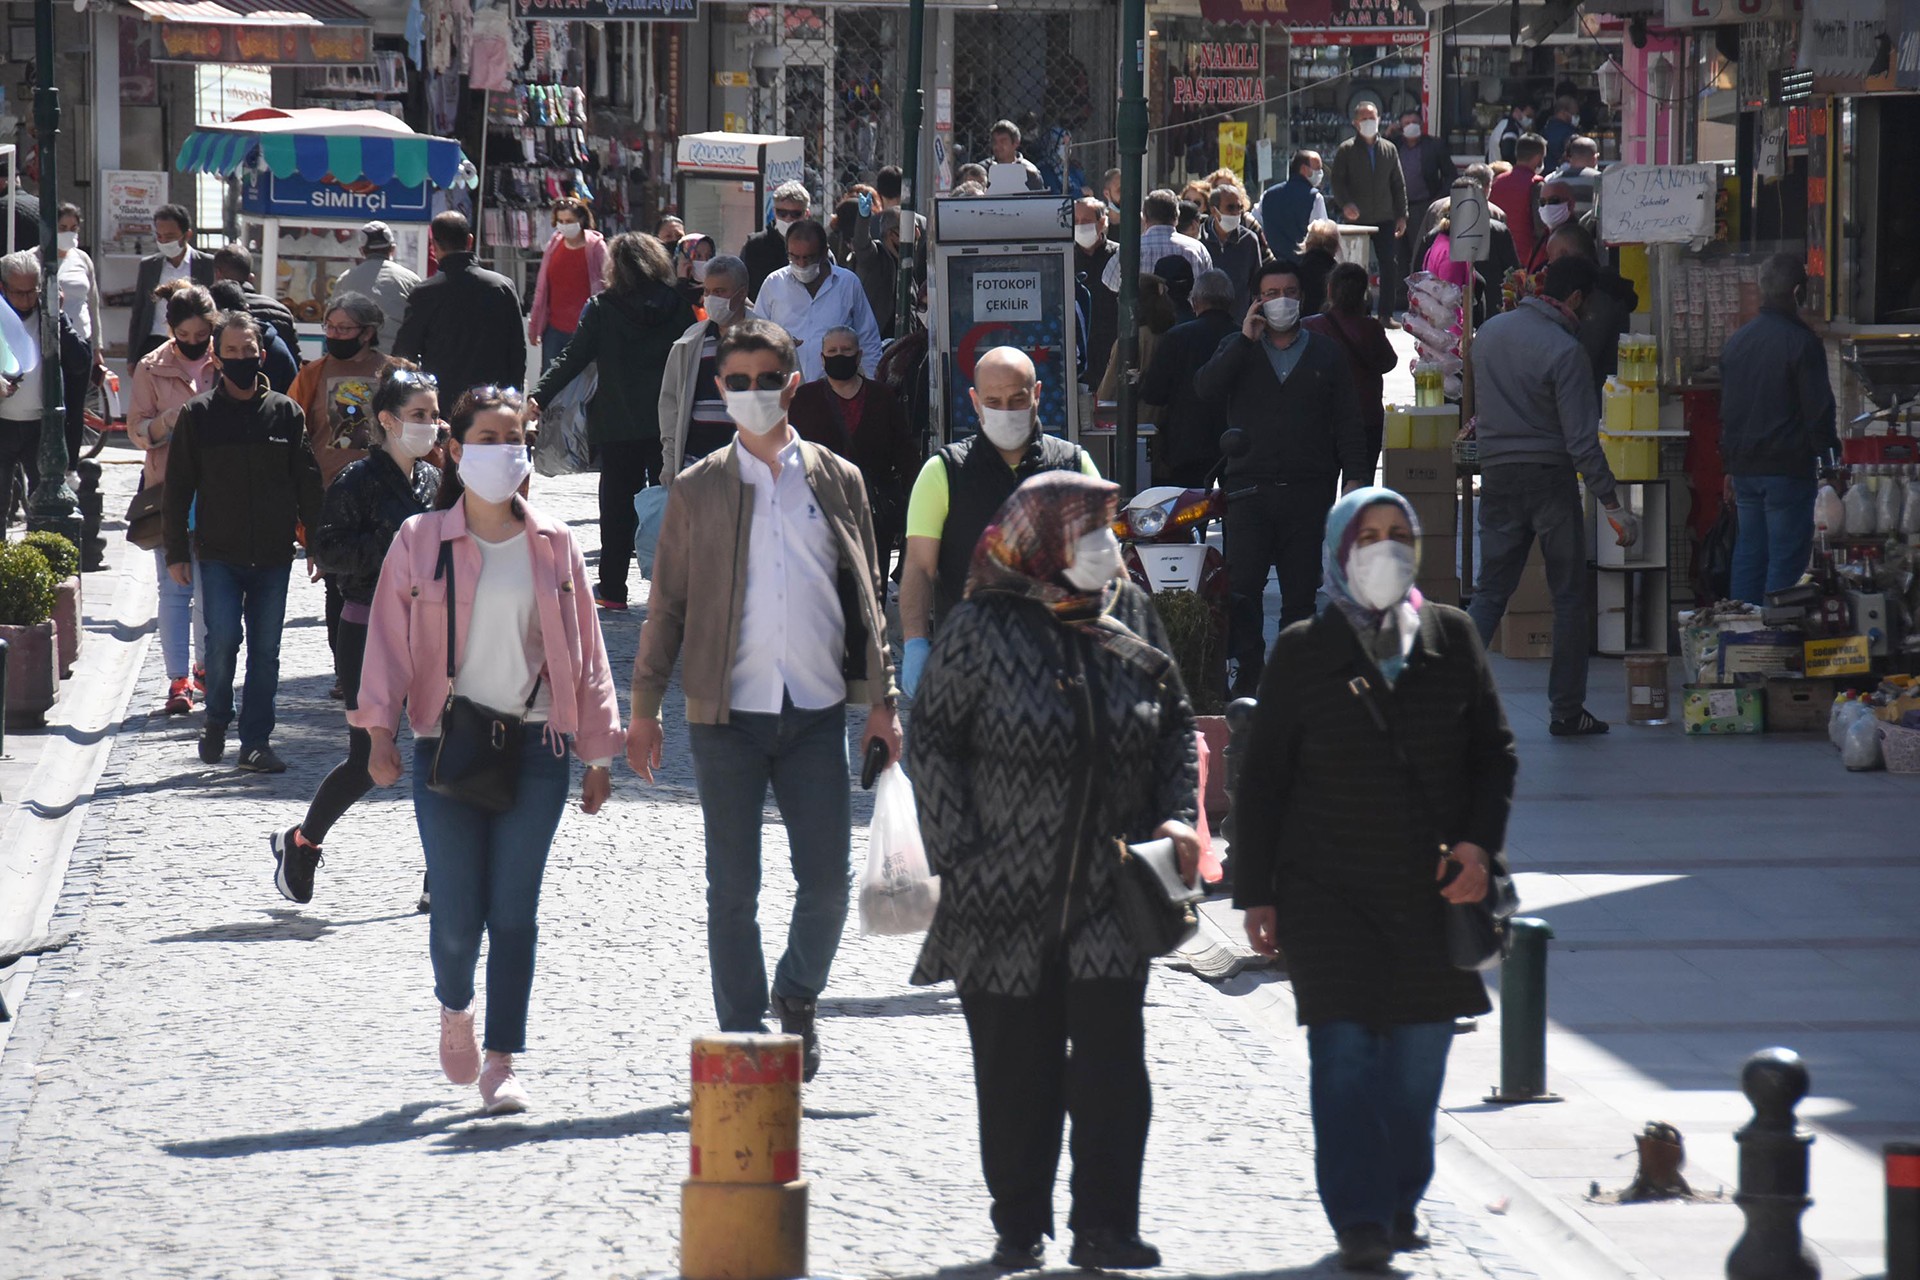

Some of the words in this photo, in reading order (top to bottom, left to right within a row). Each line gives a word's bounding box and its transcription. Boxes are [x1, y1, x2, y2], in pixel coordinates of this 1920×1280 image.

[1392, 33, 1424, 43] CASIO
[1200, 42, 1259, 69] NAMLI
[1173, 76, 1265, 103] PASTIRMA
[311, 188, 387, 213] SİMİTÇİ
[1456, 198, 1483, 239] 2
[976, 277, 1036, 290] FOTOKOPİ
[986, 298, 1029, 312] ÇEKİLİR
